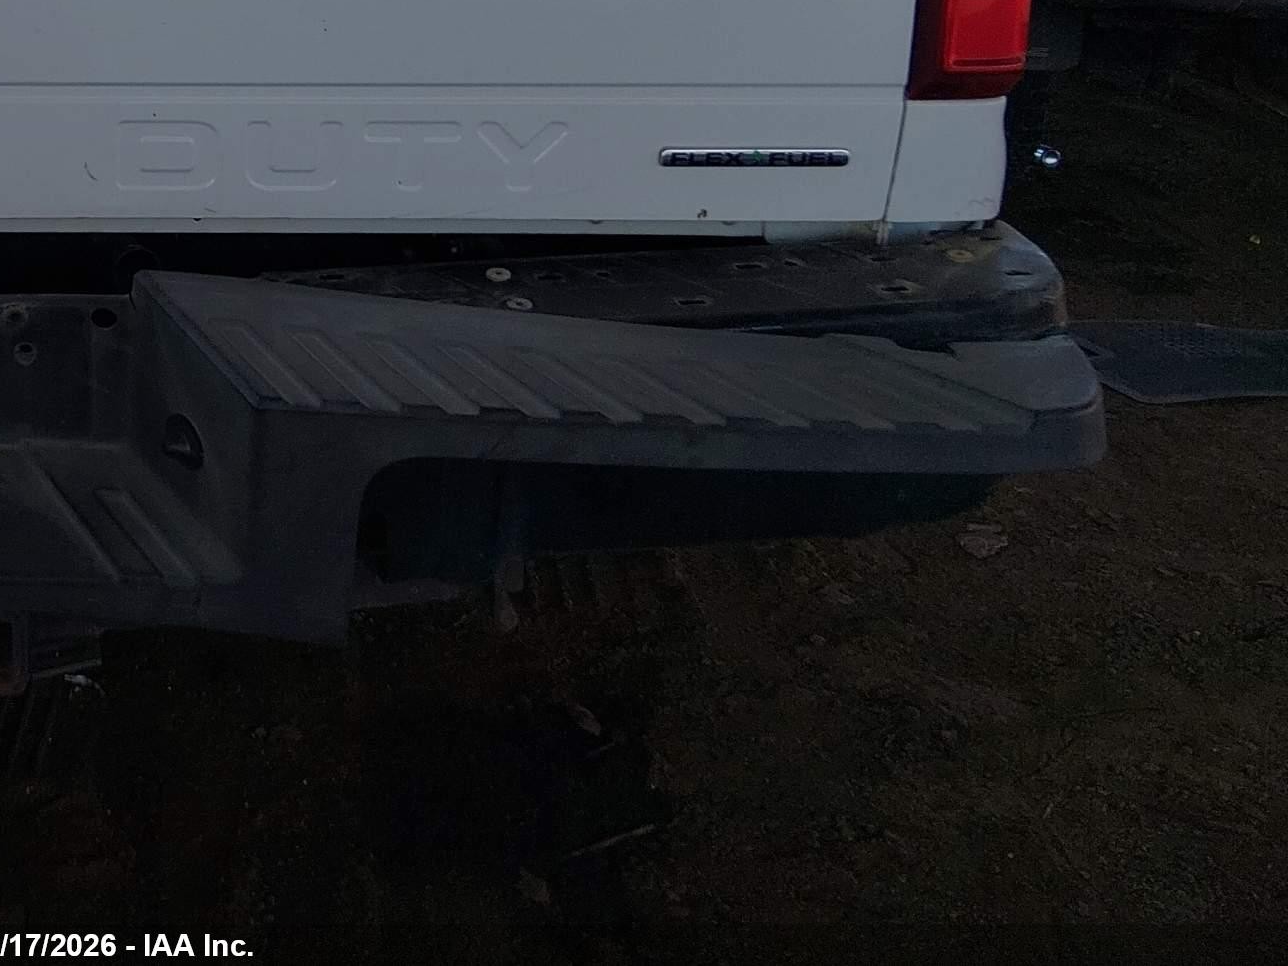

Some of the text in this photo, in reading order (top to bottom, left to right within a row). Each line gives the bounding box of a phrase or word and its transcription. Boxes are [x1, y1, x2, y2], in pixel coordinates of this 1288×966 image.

[115, 118, 569, 192] DUTY
[670, 151, 844, 166] FLEX FUEL
